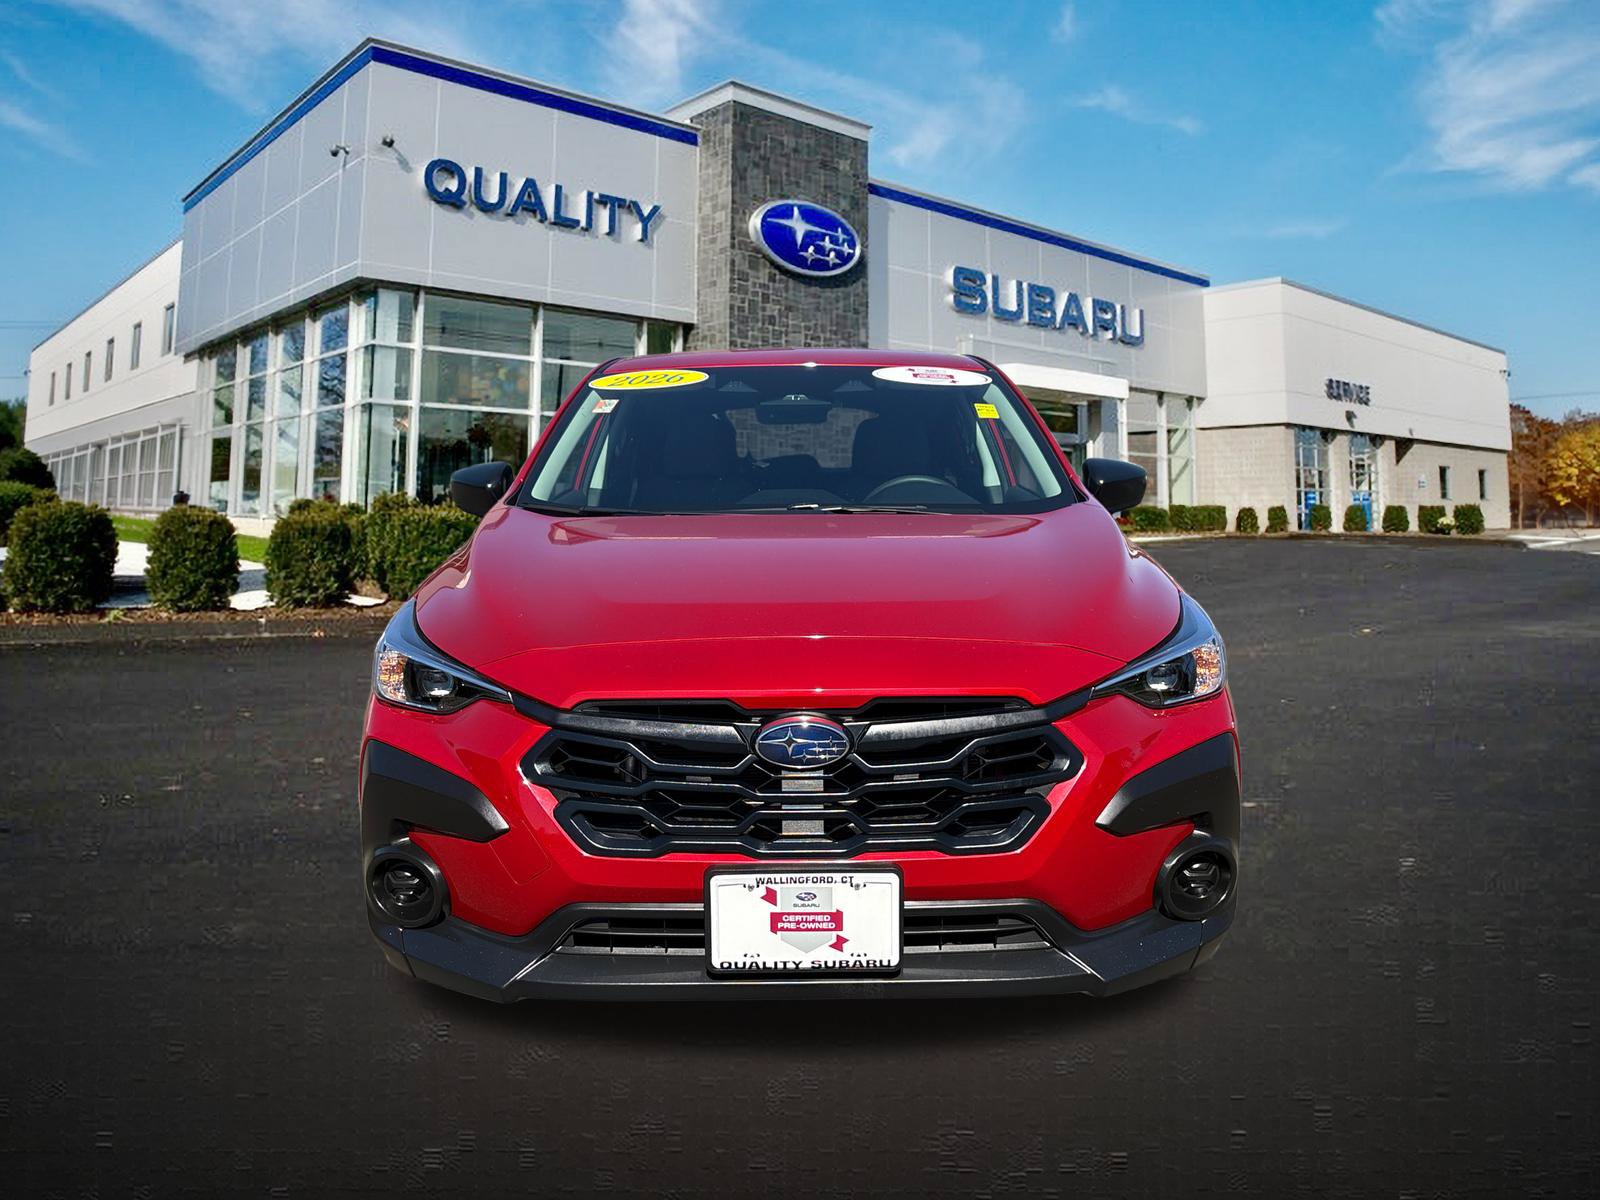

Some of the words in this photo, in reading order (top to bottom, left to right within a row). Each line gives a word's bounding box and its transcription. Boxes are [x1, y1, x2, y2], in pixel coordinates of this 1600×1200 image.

[423, 158, 662, 243] QUALITY
[950, 265, 1145, 346] SUBARU
[607, 372, 690, 387] 2026
[1325, 378, 1371, 406] SERVICE
[755, 876, 837, 886] WALLINGFORD,
[841, 876, 855, 884] CT
[782, 914, 831, 922] CERTIFIED
[719, 960, 803, 970] QUALITY
[810, 959, 892, 969] SUBARU
